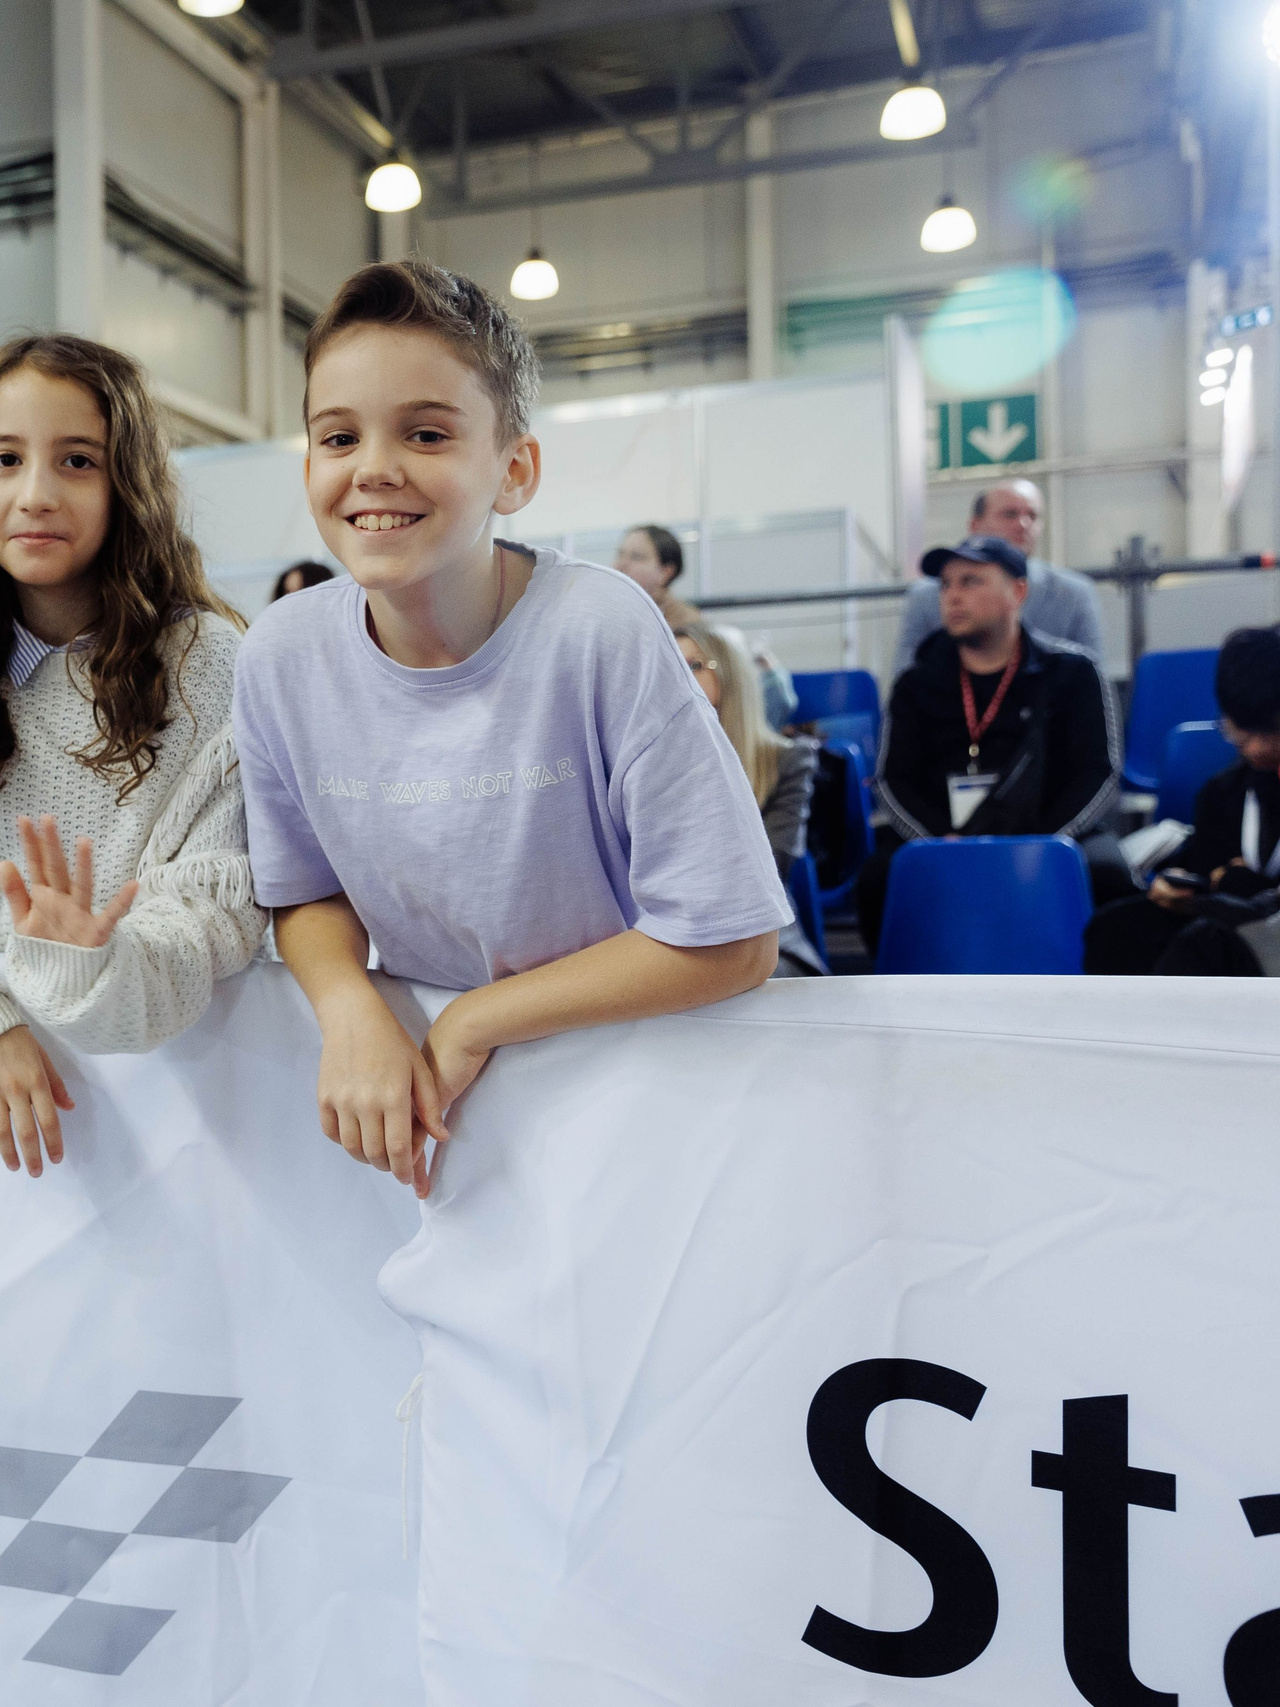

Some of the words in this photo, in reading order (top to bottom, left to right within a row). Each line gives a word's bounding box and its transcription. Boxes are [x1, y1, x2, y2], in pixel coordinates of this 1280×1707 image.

[378, 779, 451, 804] WAVES
[461, 771, 513, 799] NOT
[520, 757, 577, 790] WAR
